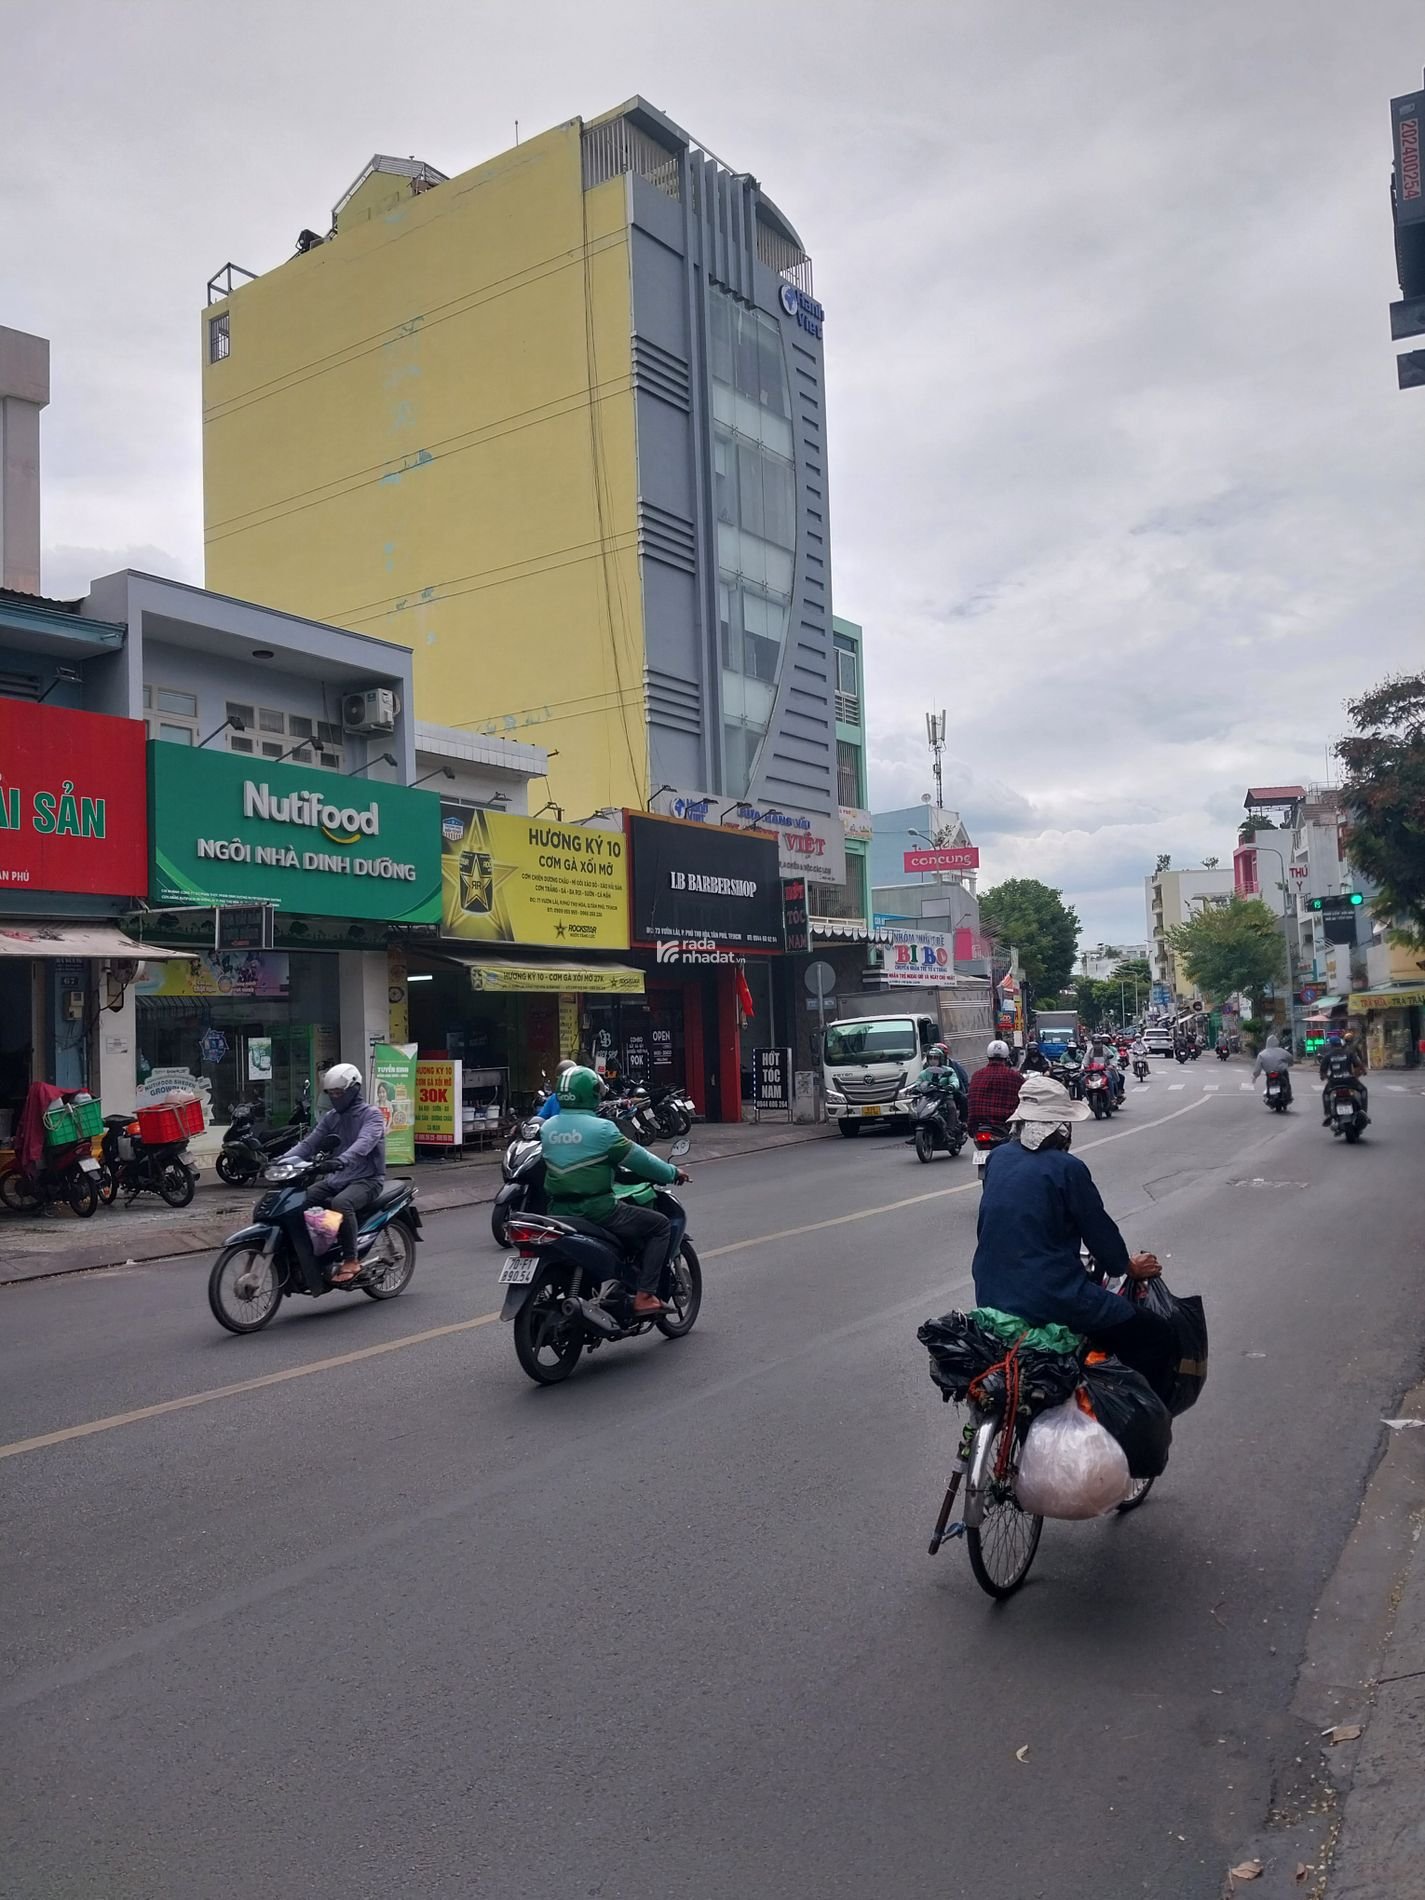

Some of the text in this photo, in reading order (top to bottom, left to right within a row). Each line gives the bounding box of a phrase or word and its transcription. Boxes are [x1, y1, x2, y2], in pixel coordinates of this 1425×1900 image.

[1402, 120, 1420, 199] 202400254
[33, 781, 106, 838] SẢN
[244, 780, 379, 836] Nutifood
[529, 828, 620, 857] HƯƠNG KÝ 10
[783, 832, 825, 856] VIỆT
[197, 837, 416, 880] NGÔI NHÀ DINH DƯỠNG
[539, 855, 613, 876] CƠM GÀ XỐI MỠ
[1289, 864, 1308, 878] THÚ
[671, 872, 756, 897] LB BARBERSHOP
[1297, 881, 1303, 891] Y
[569, 924, 597, 933] ROCKSTAR
[894, 944, 948, 966] BI BO
[652, 1031, 671, 1041] OPEN
[630, 1055, 644, 1065] 90K
[763, 1067, 780, 1082] TÓC
[420, 1088, 448, 1103] 30K
[762, 1085, 782, 1098] NAM
[549, 1129, 583, 1144] Grab
[509, 1259, 532, 1270] 70-F1
